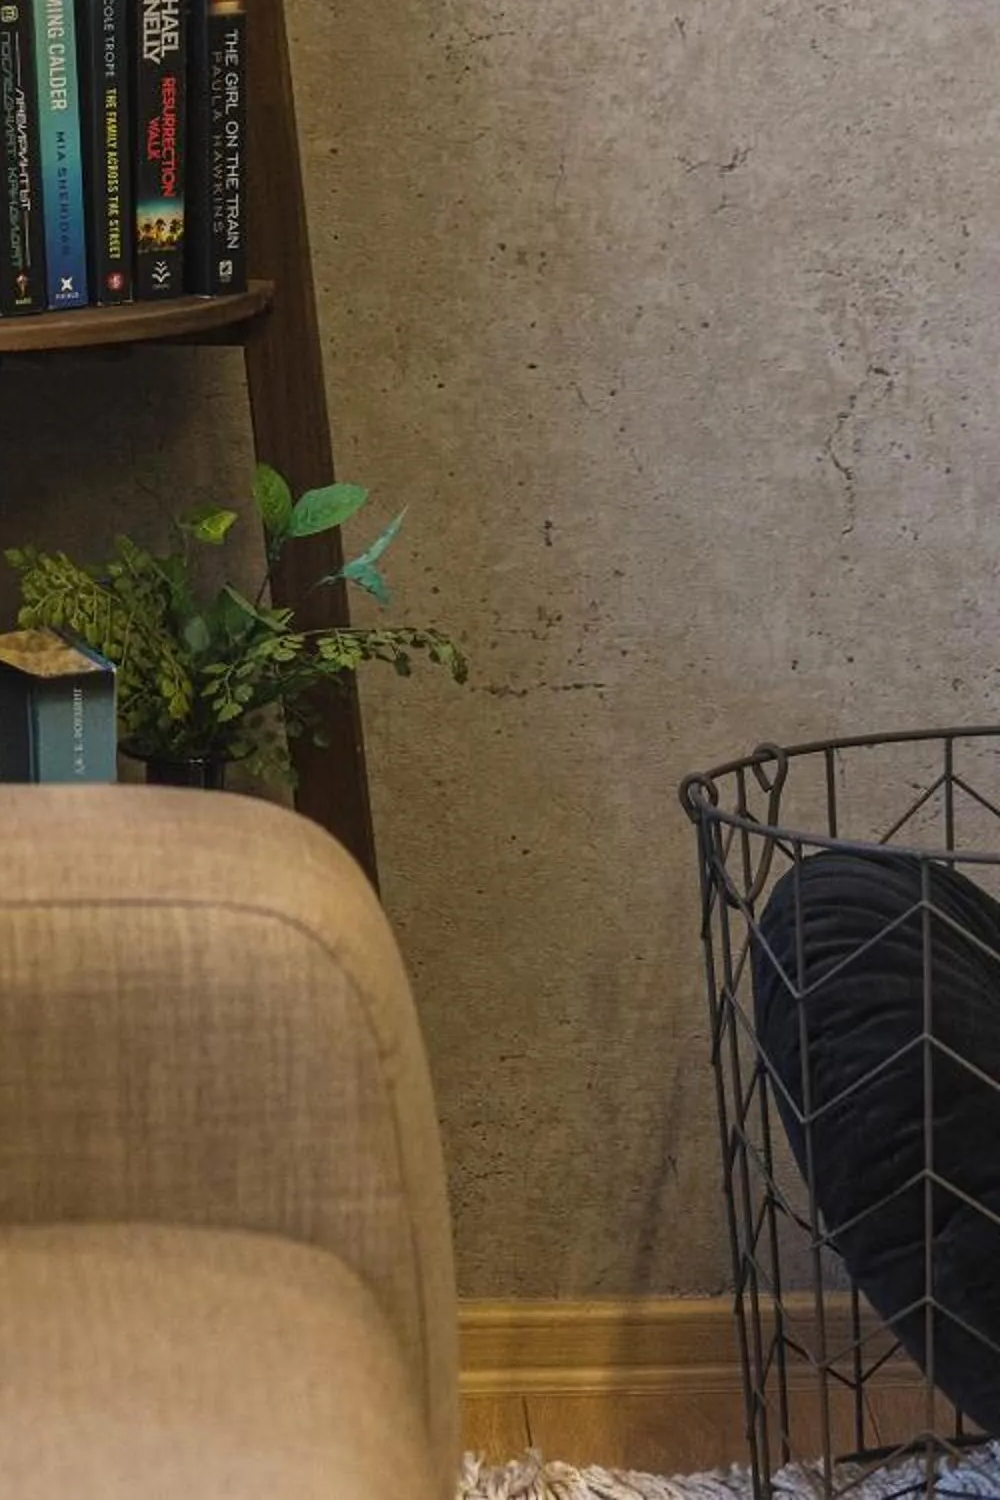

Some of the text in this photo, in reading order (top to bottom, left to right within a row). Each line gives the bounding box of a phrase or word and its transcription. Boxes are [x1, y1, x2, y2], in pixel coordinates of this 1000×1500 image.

[48, 43, 69, 111] CALDER
[105, 35, 116, 79] TROPE
[106, 88, 118, 109] THE
[56, 131, 67, 161] MIA
[106, 111, 119, 148] FAMILY
[147, 116, 161, 162] WALK
[161, 76, 177, 197] RESURRECTION
[211, 50, 225, 234] PAULA HAWKINS
[225, 29, 240, 251] THE GIRL ON THE TRAIN
[107, 150, 120, 192] ACROSS
[108, 194, 121, 217] THE
[108, 218, 122, 260] STREET
